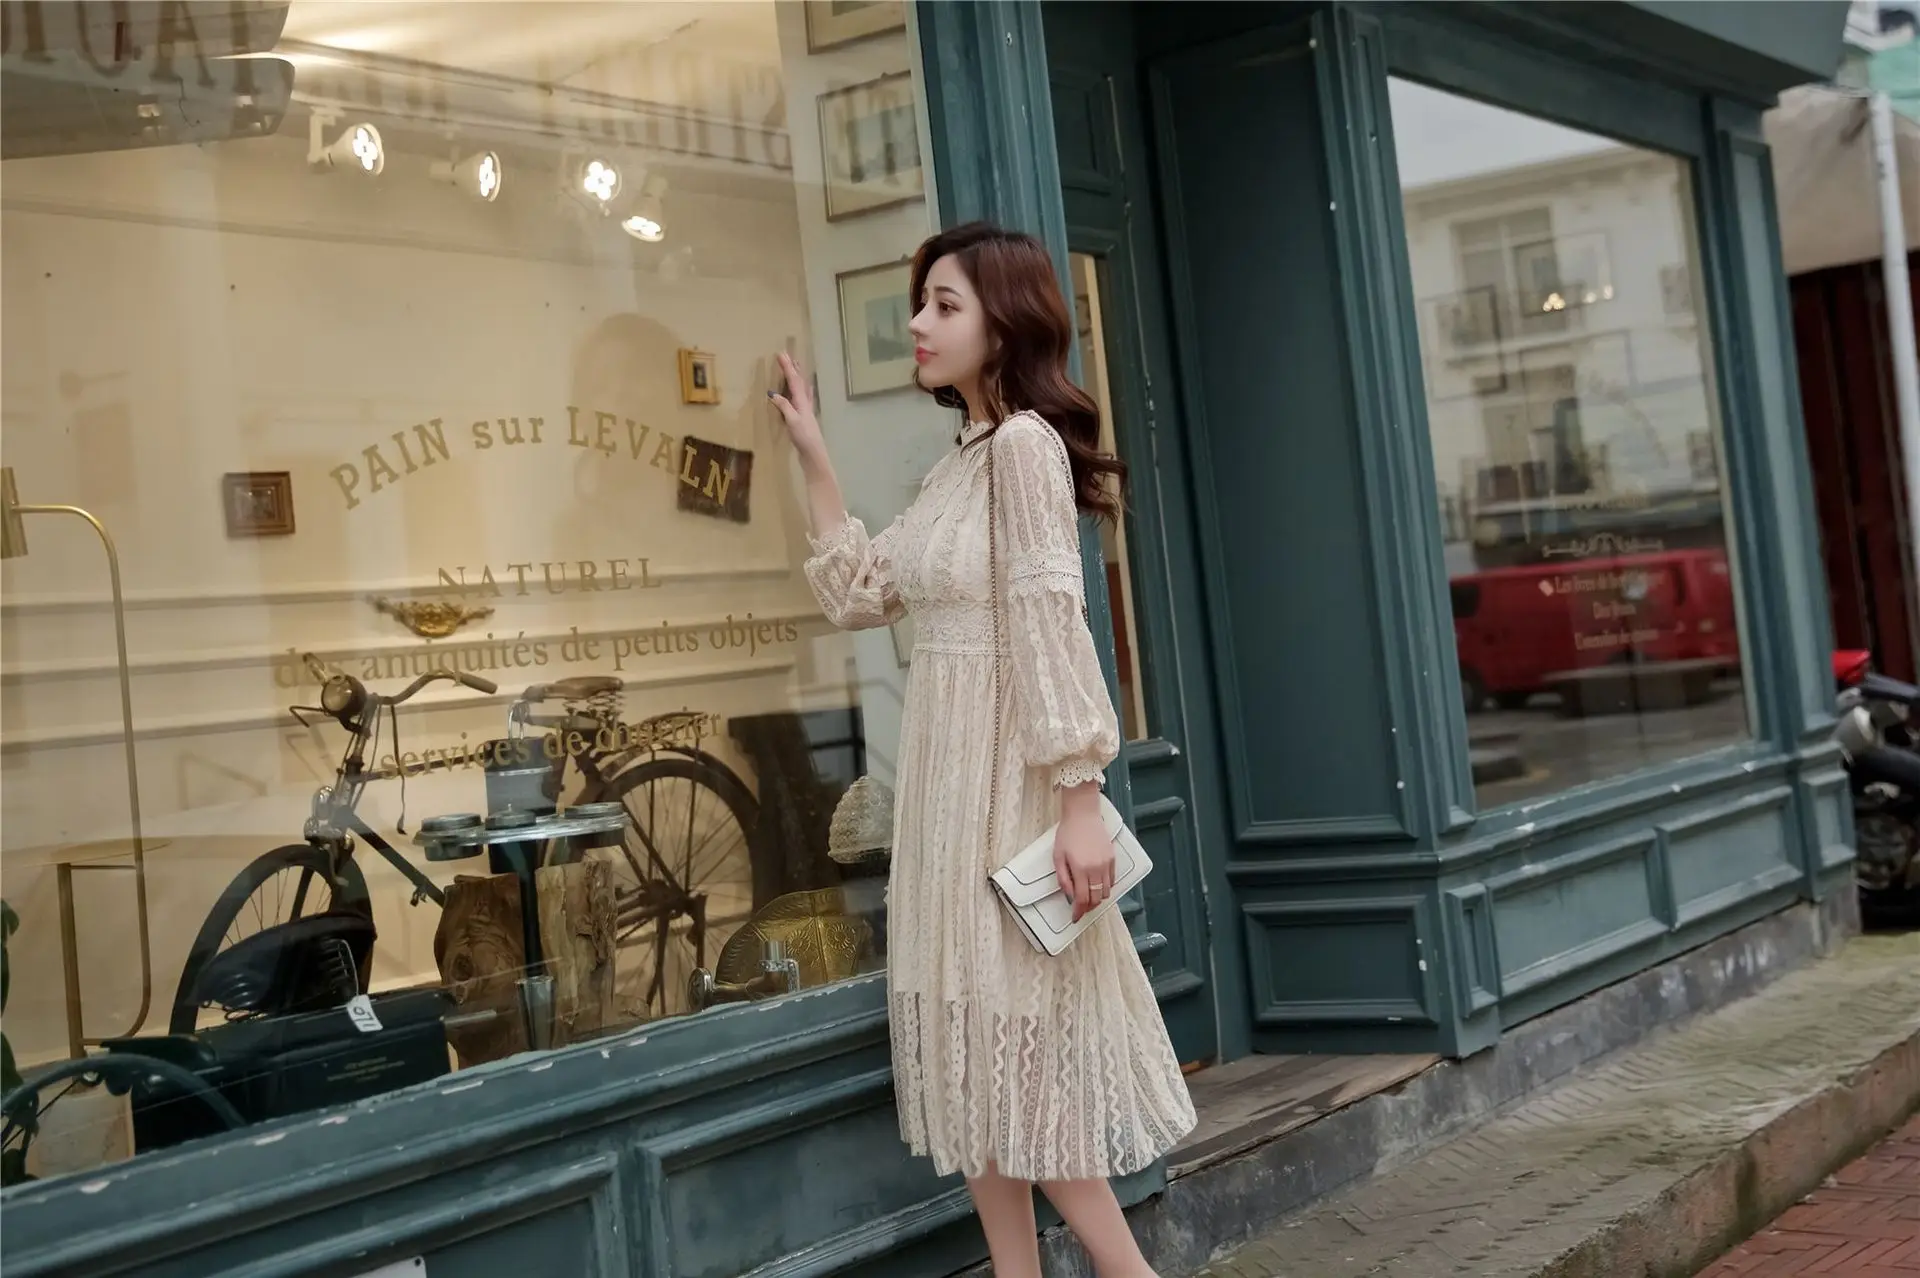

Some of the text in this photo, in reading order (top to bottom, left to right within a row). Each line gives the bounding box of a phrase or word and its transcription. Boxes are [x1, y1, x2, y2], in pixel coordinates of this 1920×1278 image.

[329, 417, 451, 510] PAIN
[472, 416, 545, 450] sur
[437, 557, 663, 599] NATUREL
[361, 632, 549, 688] antiquités
[560, 626, 601, 663] de
[613, 620, 699, 671] petits
[709, 613, 799, 658] objets
[380, 731, 530, 780] services
[543, 721, 583, 760] de
